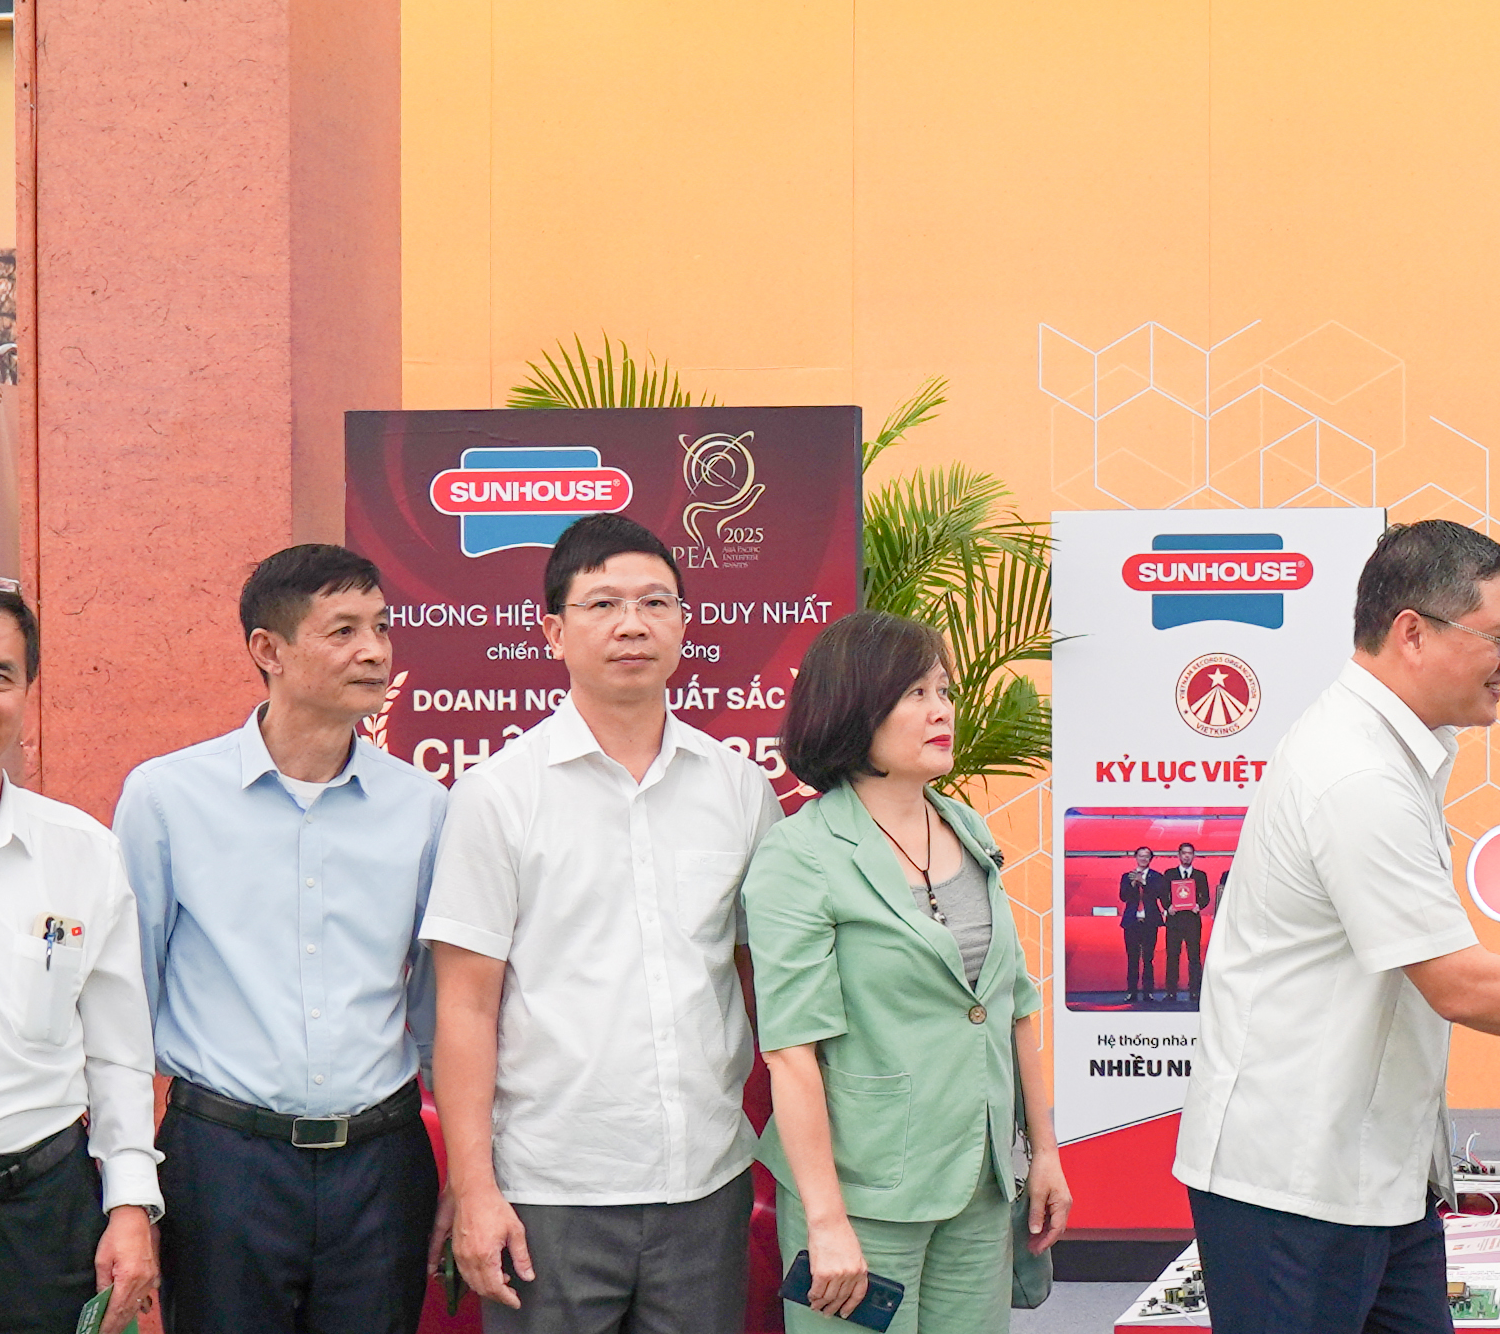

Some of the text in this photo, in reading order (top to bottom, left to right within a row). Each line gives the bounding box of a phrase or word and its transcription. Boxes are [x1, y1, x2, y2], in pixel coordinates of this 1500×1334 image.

[723, 527, 764, 544] 2025
[671, 546, 719, 569] PEA
[386, 602, 489, 627] HƯƠNG
[700, 601, 755, 625] DUY
[762, 593, 833, 625] NHẤT
[486, 640, 539, 660] chiến
[413, 688, 517, 712] DOANH
[665, 673, 720, 710] UẤT
[726, 674, 786, 710] SẮC
[1196, 722, 1240, 735] VIETKINGS
[1095, 753, 1268, 790] KỶ LỤC VIỆT
[1097, 1033, 1116, 1049] Hệ
[1119, 1033, 1160, 1049] thống
[1162, 1034, 1188, 1046] nhà
[1089, 1053, 1163, 1077] NHIỀU
